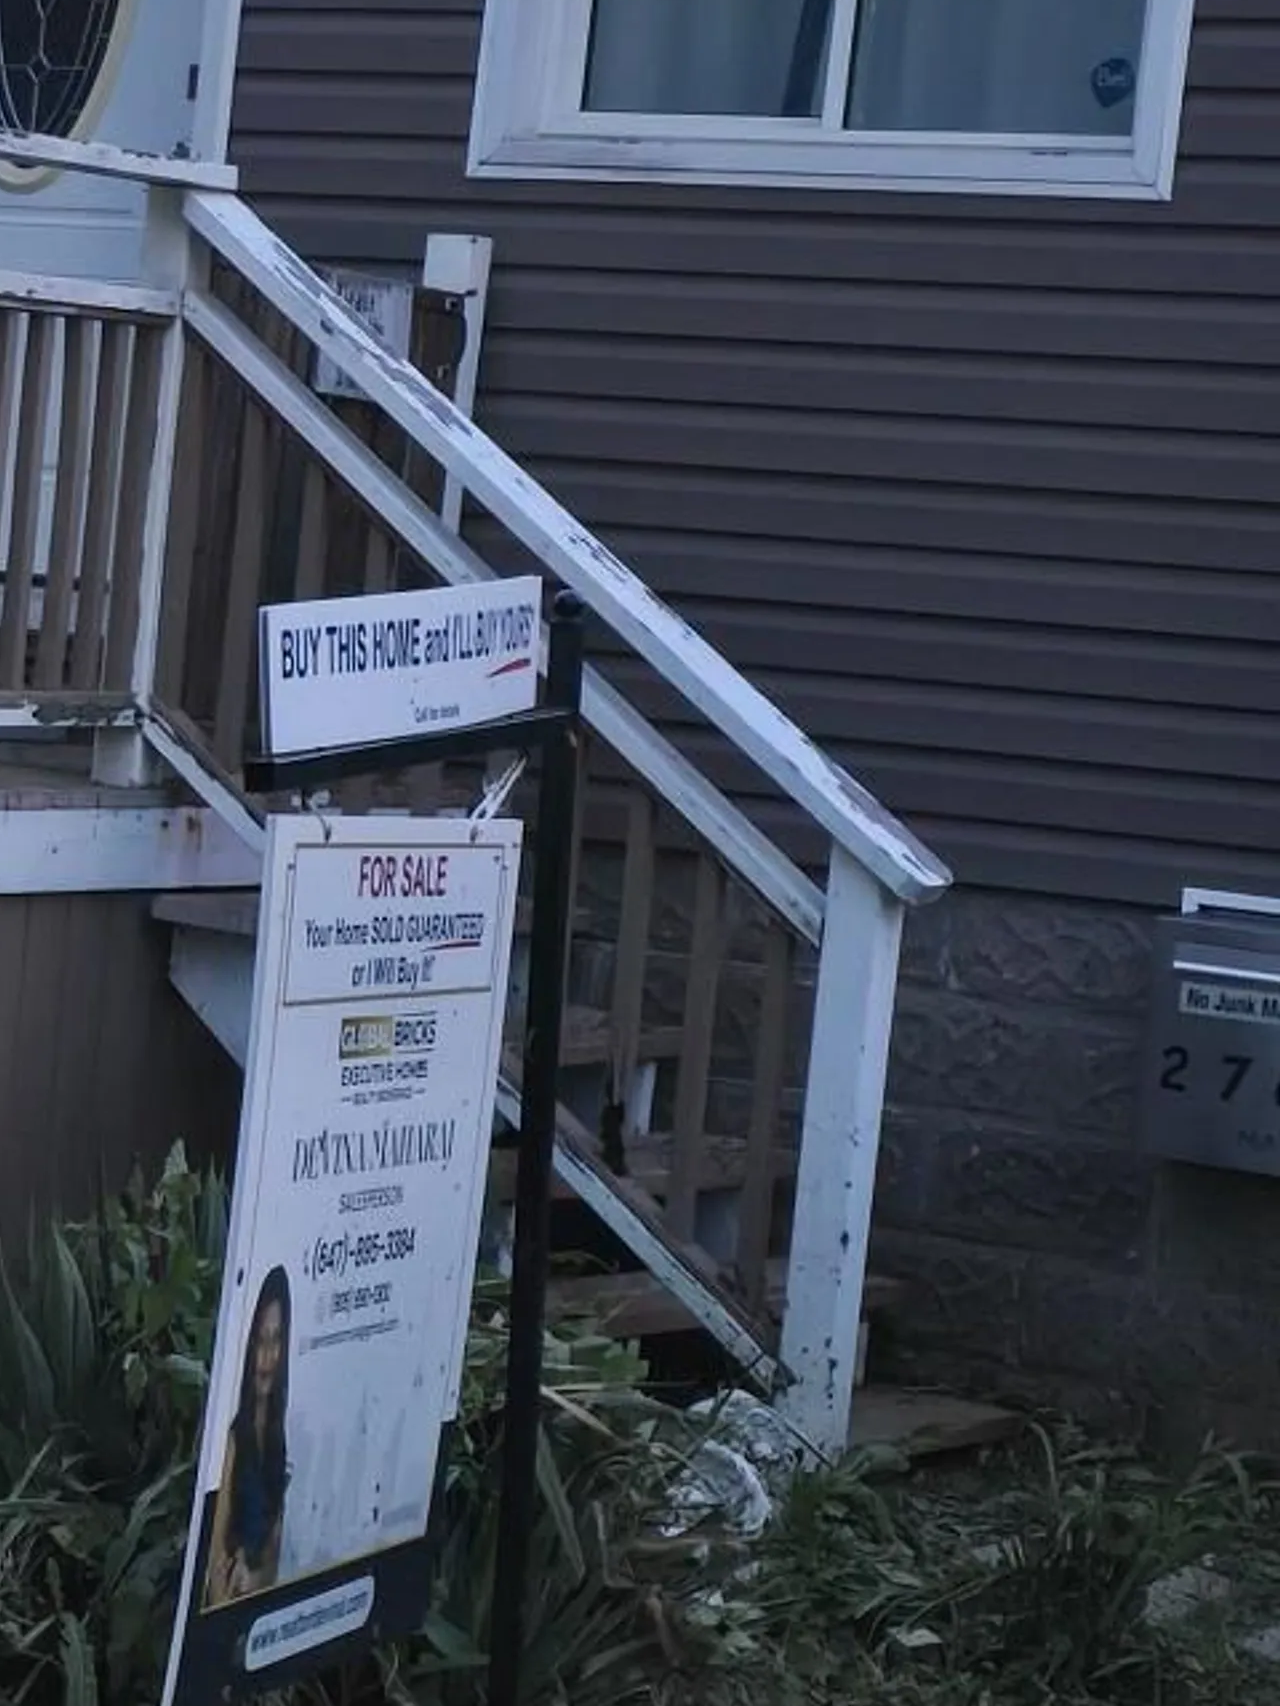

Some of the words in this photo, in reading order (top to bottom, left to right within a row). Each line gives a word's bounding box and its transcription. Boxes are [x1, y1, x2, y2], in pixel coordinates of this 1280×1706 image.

[281, 627, 321, 679] BUY
[326, 624, 366, 674] THIS
[373, 619, 420, 670] HOME
[425, 615, 449, 664] and
[358, 855, 396, 897] FOR
[400, 855, 448, 897] SALE
[305, 919, 333, 948] Your
[335, 916, 368, 944] Home
[371, 914, 404, 944] SOLD
[406, 912, 484, 942] GUARANTEED
[352, 964, 366, 987] or
[398, 956, 419, 990] Buy
[1187, 988, 1209, 1009] No
[1213, 993, 1254, 1014] Junk
[394, 1019, 437, 1046] BRICKS
[1160, 1046, 1280, 1109] 27
